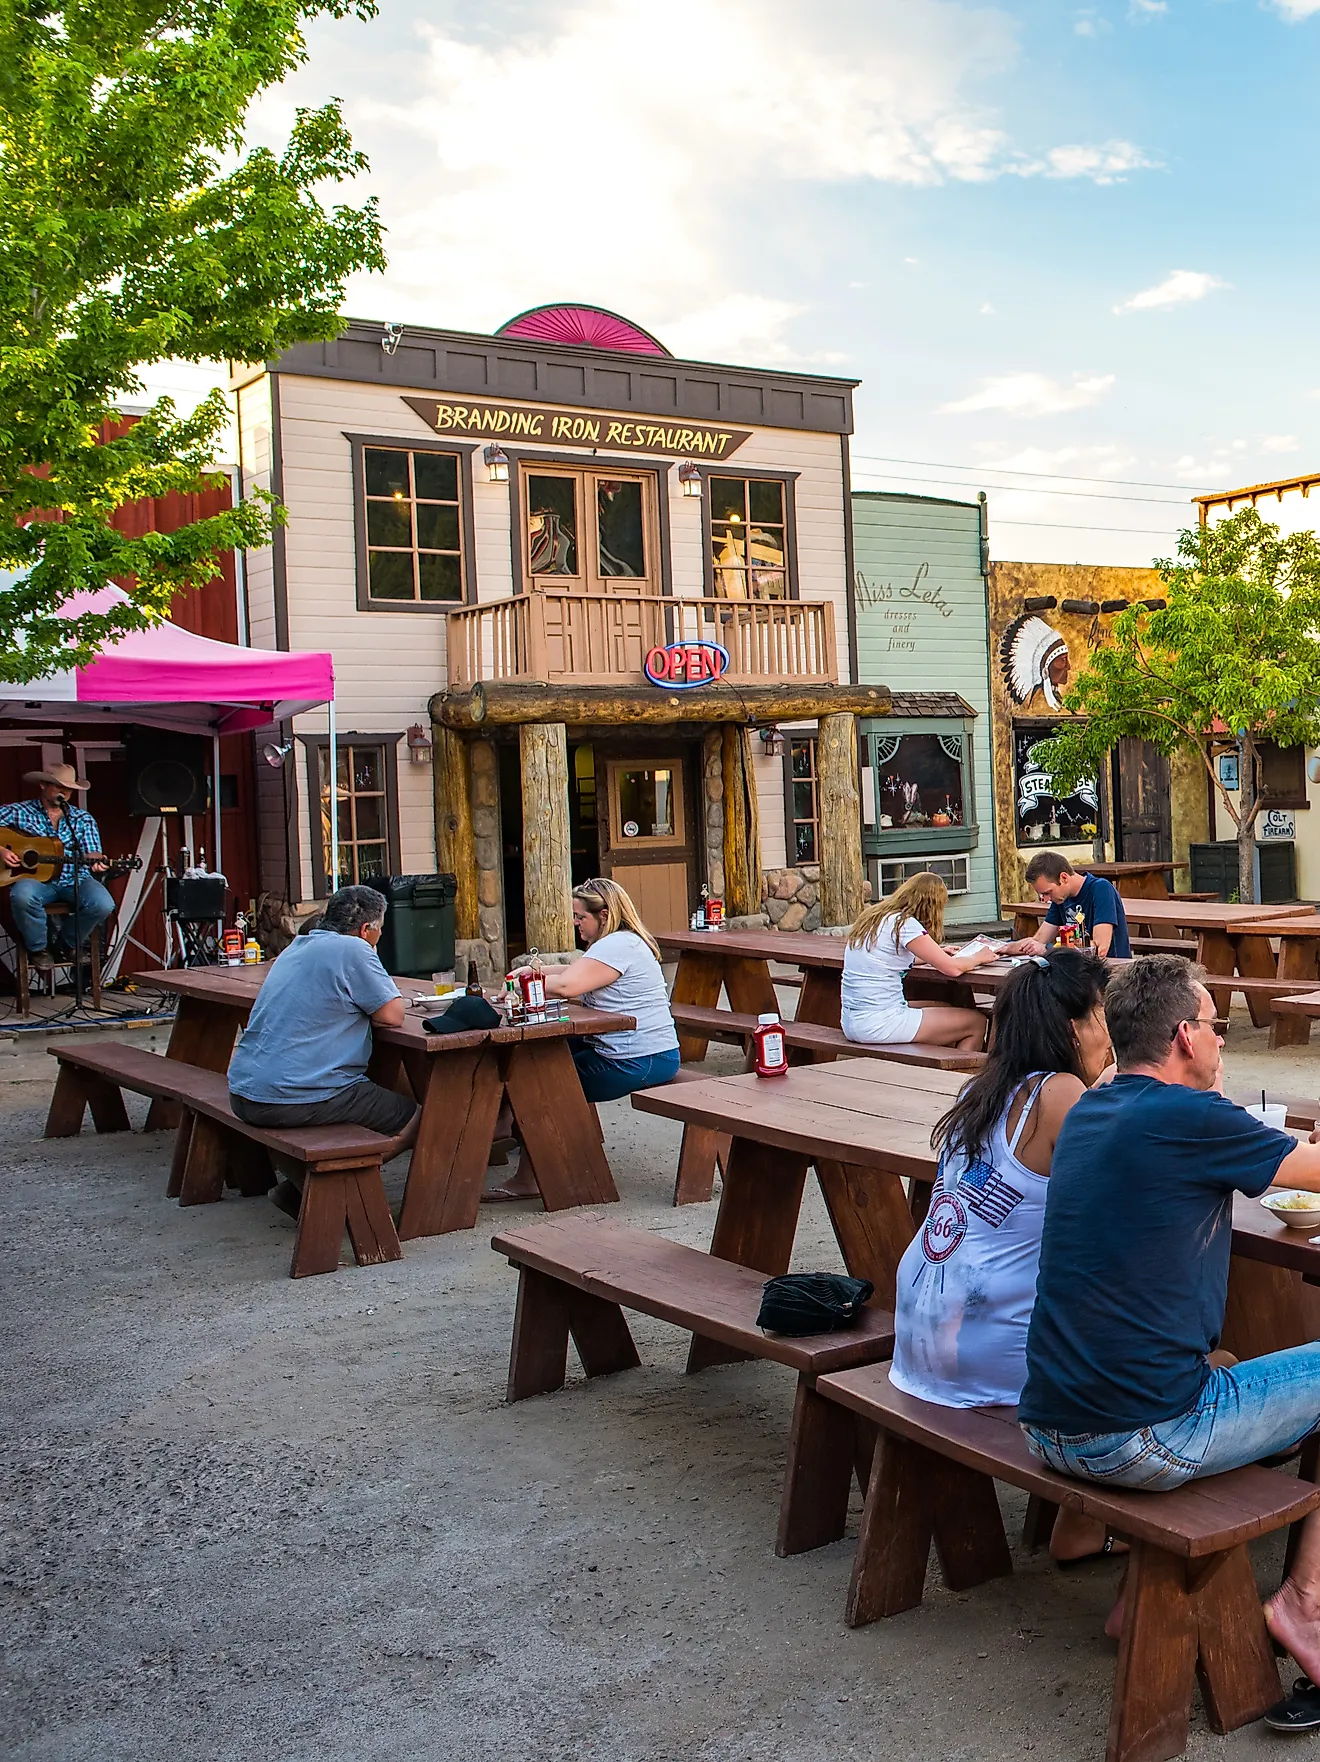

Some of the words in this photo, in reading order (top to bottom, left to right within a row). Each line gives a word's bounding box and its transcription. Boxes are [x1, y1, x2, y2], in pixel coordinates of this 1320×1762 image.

[435, 404, 545, 436] BRANDING
[551, 416, 600, 443] IRON
[605, 421, 733, 454] RESTAURANT
[884, 609, 917, 620] dresses
[892, 622, 911, 633] and
[886, 637, 916, 652] finery
[646, 646, 721, 680] OPEN
[1268, 809, 1288, 827] COLT
[1263, 822, 1294, 837] FIREARMS
[934, 1215, 953, 1239] 66
